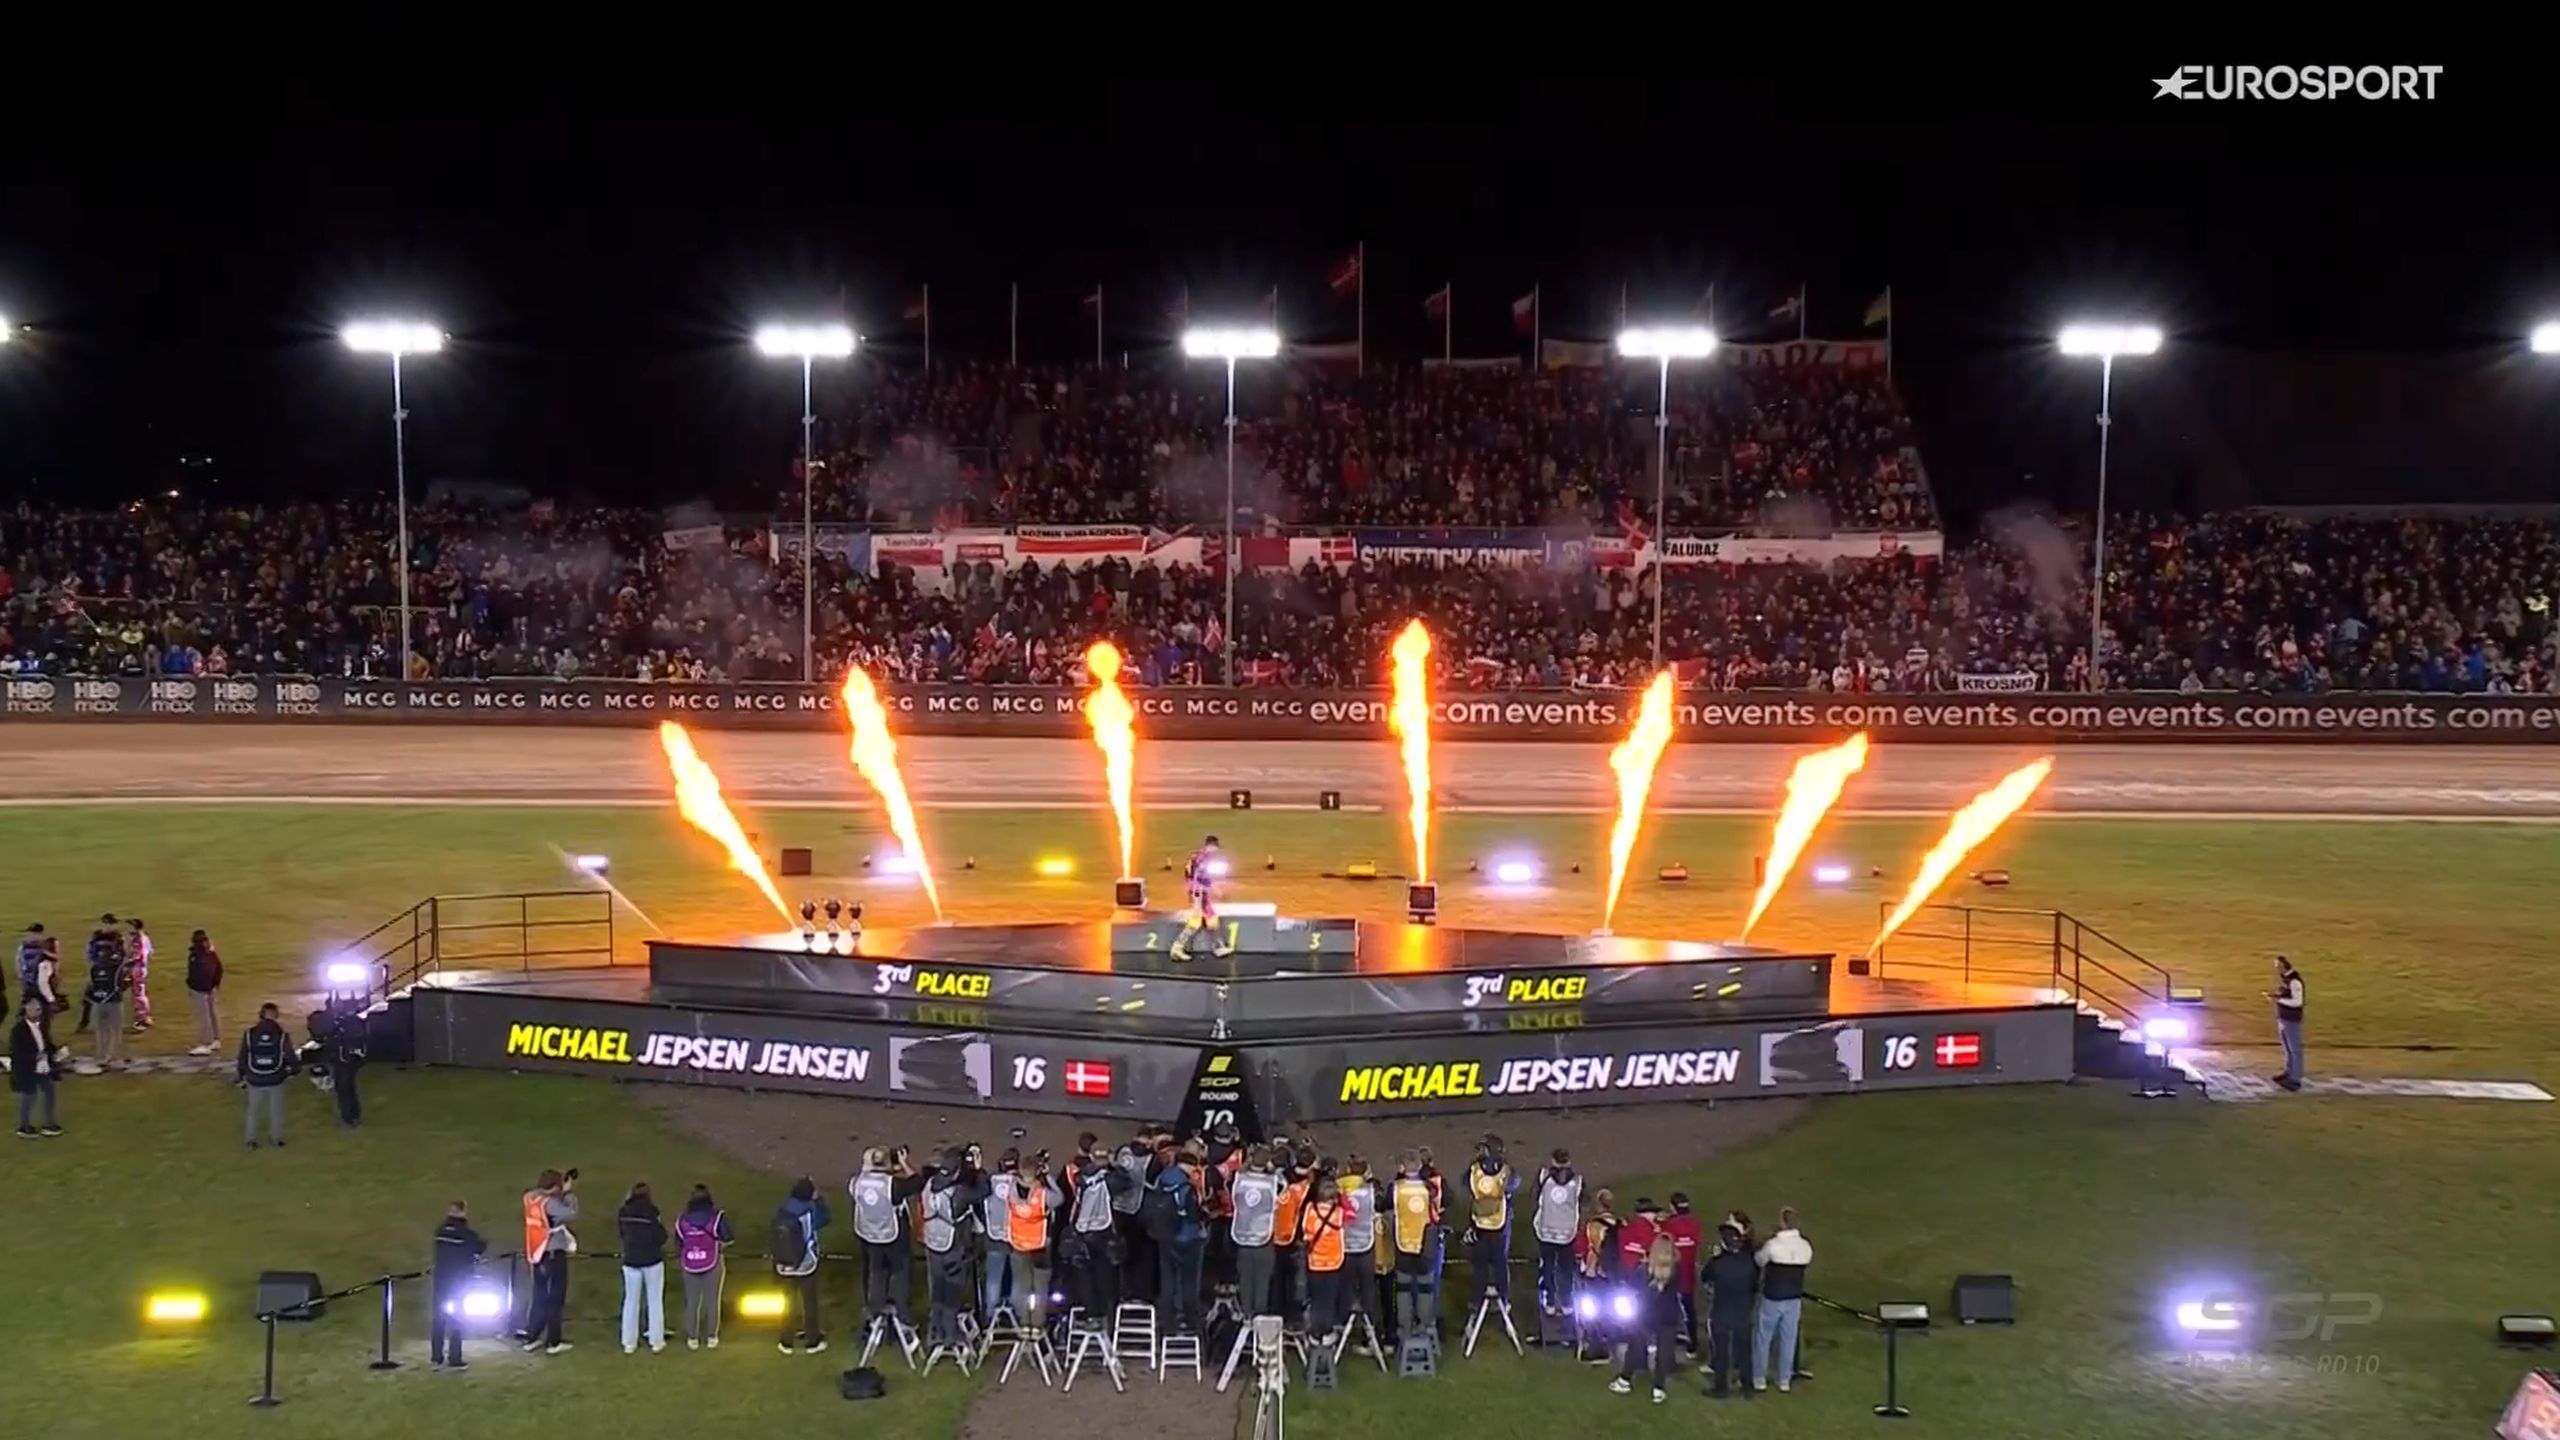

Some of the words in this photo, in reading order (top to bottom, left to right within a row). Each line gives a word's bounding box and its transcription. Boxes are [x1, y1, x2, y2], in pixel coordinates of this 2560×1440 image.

[6, 681, 56, 700] HBO
[74, 681, 121, 700] HBO
[152, 681, 197, 700] HBO
[213, 682, 258, 701] HBO
[276, 683, 321, 701] HBO
[1963, 679, 2034, 690] KROSNO
[7, 701, 54, 713] max
[74, 701, 119, 713] max
[152, 701, 196, 713] max
[214, 701, 257, 714] max
[276, 702, 320, 715] max
[344, 692, 397, 707] MCG
[409, 693, 461, 707] MCG
[473, 693, 526, 708] MCG
[540, 694, 592, 708] MCG
[604, 694, 656, 709] MCG
[668, 694, 720, 709] MCG
[734, 695, 786, 710] MCG
[799, 696, 832, 710] MC
[886, 696, 914, 710] CG
[928, 697, 980, 711] MCG
[992, 697, 1045, 712] MCG
[1057, 697, 1087, 712] MC
[1186, 699, 1239, 714] MCG
[1251, 700, 1303, 715] MCG
[1236, 794, 1246, 807] 2
[1328, 794, 1335, 808] 1
[1145, 932, 1157, 949] 2
[1227, 921, 1240, 952] 1
[1308, 932, 1321, 949] 3
[873, 963, 912, 994] 3rd
[915, 971, 992, 998] PLACE!
[1462, 974, 1504, 1008] 3rd
[1507, 976, 1587, 1002] PLACE!
[507, 1023, 632, 1063] MICHAEL
[637, 1034, 750, 1072] JEPSEN
[752, 1042, 870, 1082] JENSEN
[1884, 1036, 1918, 1069] 16
[1012, 1056, 1047, 1090] 16
[1340, 1063, 1483, 1102] MICHAEL
[1489, 1056, 1614, 1095] JEPSEN
[1615, 1049, 1741, 1088] JENSEN
[1199, 1091, 1240, 1101] ROUND
